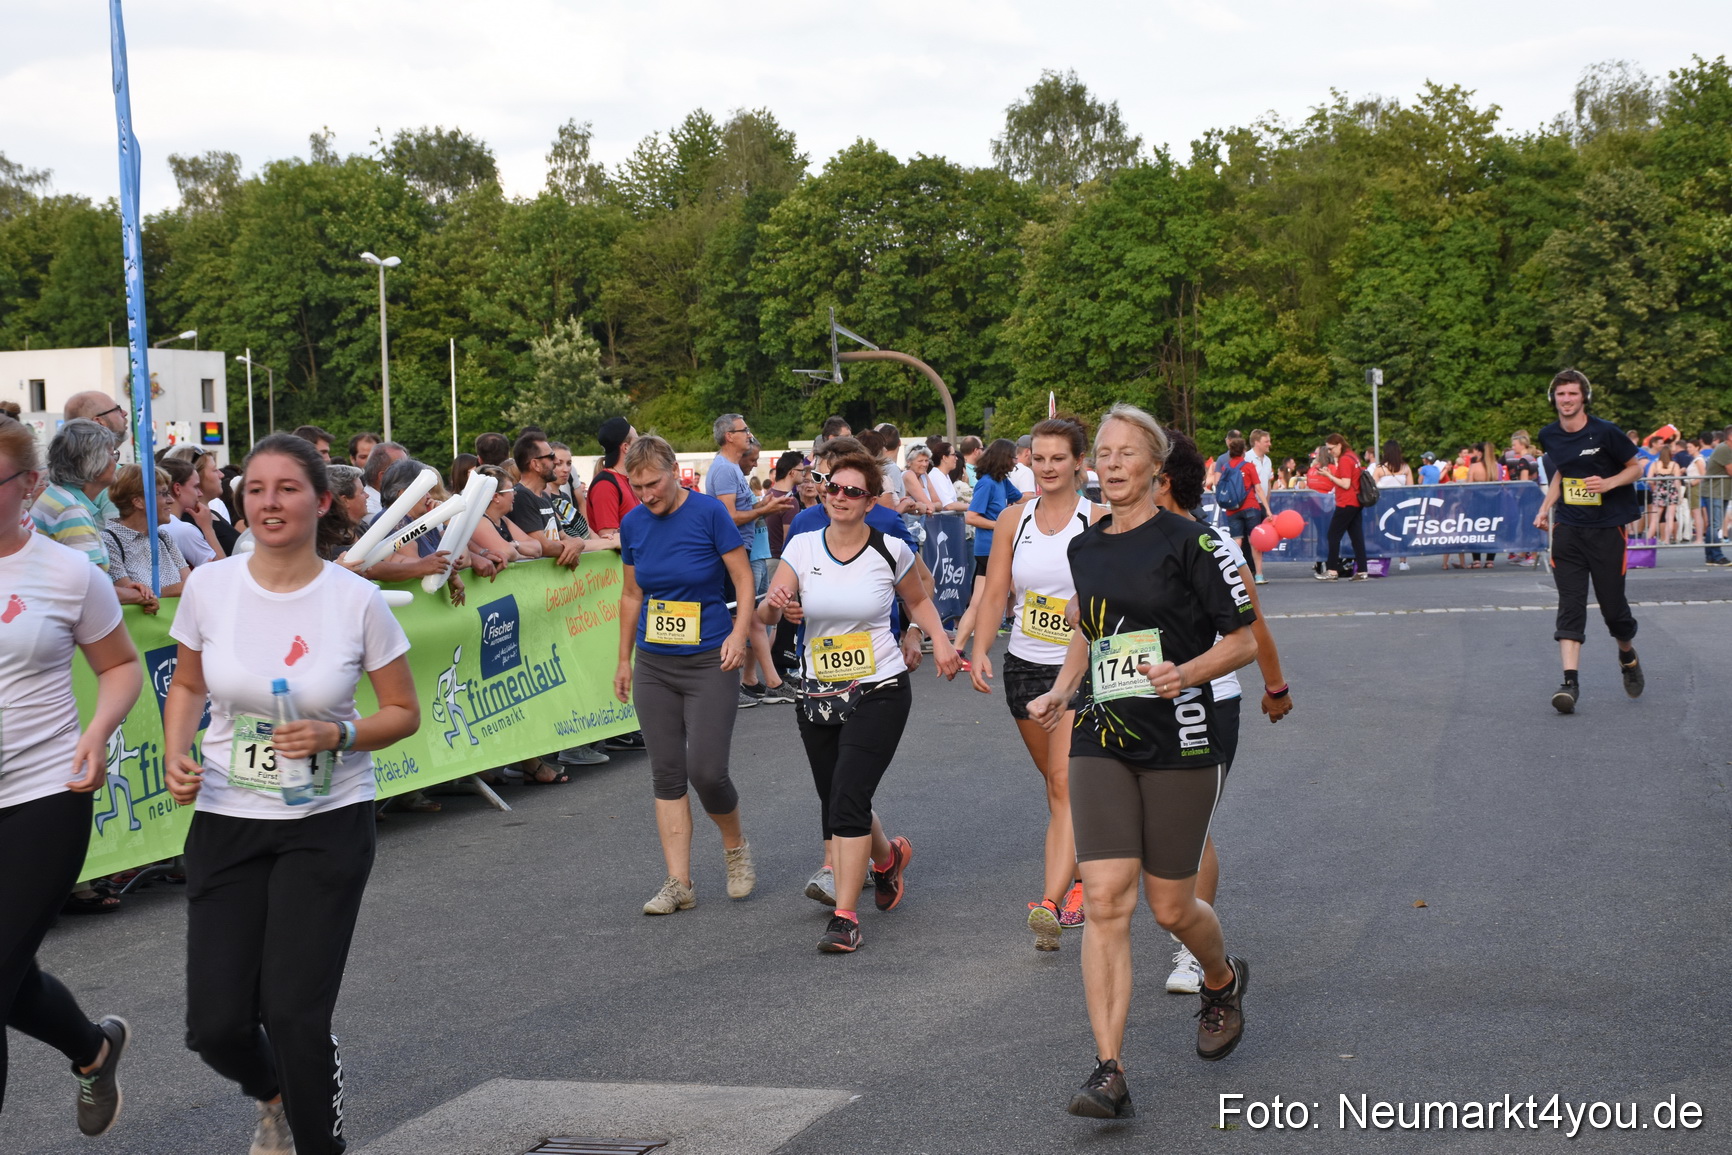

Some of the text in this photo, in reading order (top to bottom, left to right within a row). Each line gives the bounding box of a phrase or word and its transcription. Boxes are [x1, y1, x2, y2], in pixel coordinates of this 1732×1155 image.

[1402, 513, 1504, 535] Fischer
[1411, 534, 1495, 546] AUTOMOBILE
[488, 620, 515, 640] Fischer
[656, 616, 686, 632] 859
[1030, 609, 1072, 632] 1889
[820, 649, 865, 669] 1890
[1098, 653, 1152, 684] 1745
[467, 643, 566, 722] firmenlauf
[481, 707, 526, 738] neumarkt
[257, 771, 278, 780] Fürst
